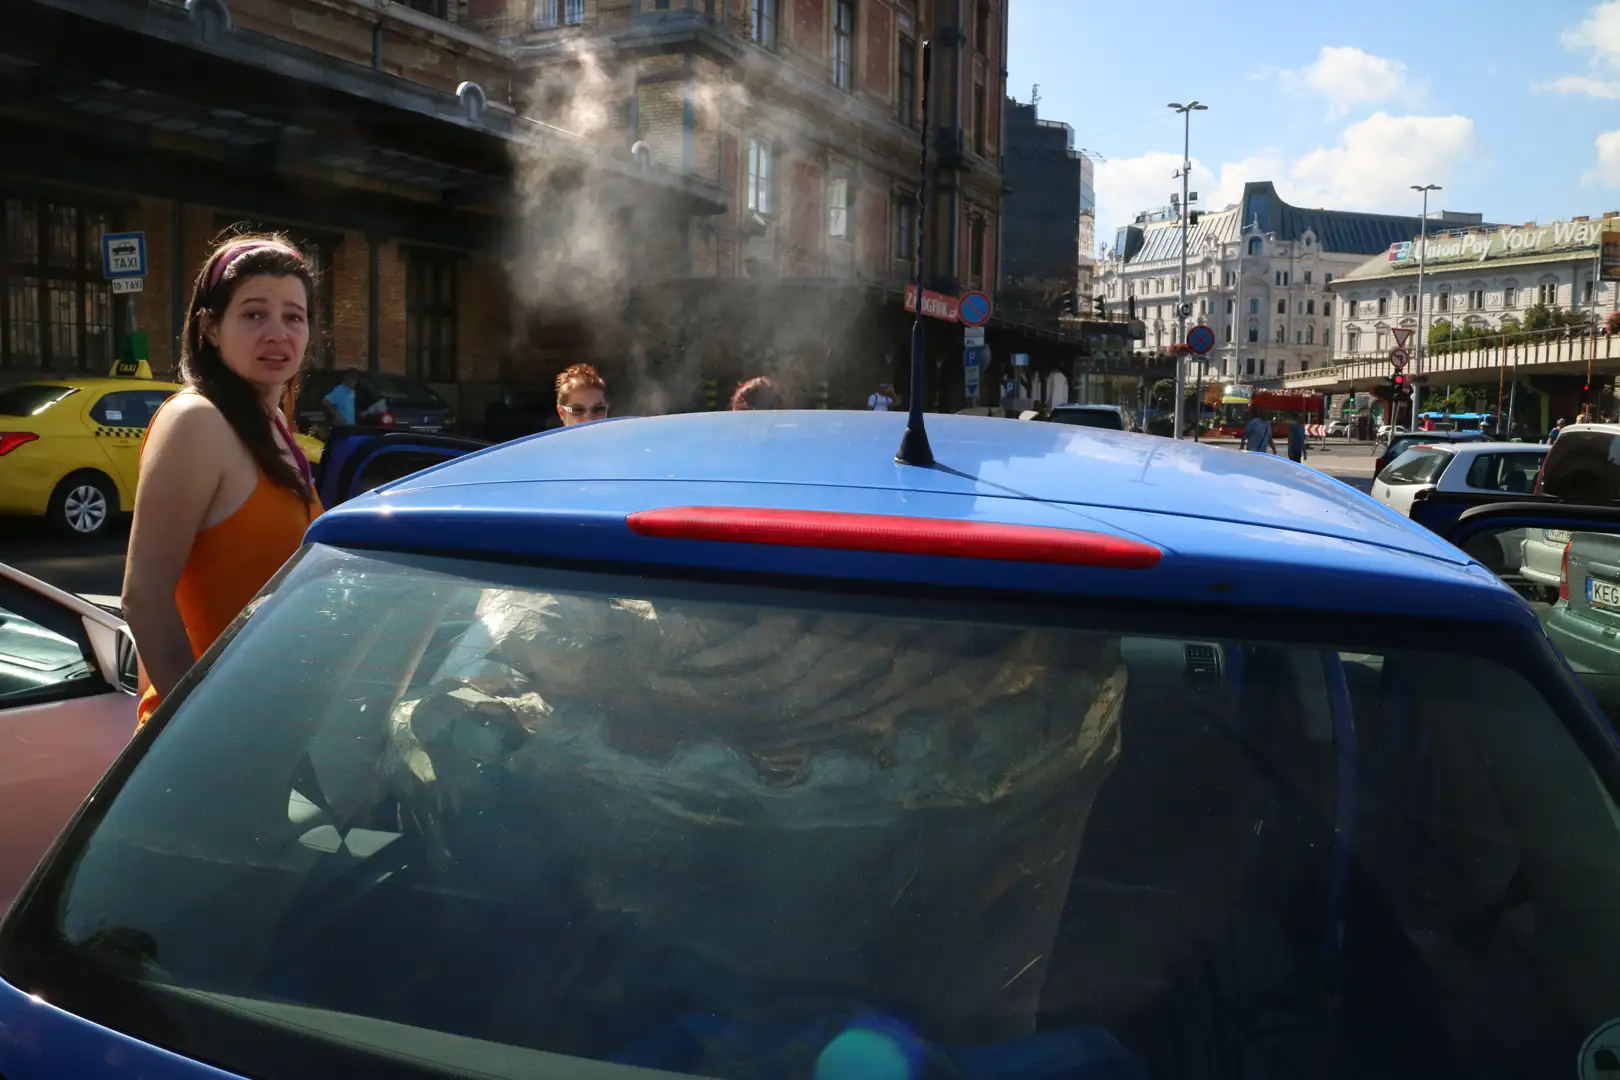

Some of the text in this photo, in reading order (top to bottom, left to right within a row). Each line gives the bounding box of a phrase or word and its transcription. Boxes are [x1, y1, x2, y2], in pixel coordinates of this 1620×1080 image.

[1414, 234, 1492, 261] UnionPay
[1501, 228, 1546, 250] Your
[1554, 221, 1601, 246] Way
[113, 256, 138, 269] TAXI
[119, 362, 137, 373] TAXI
